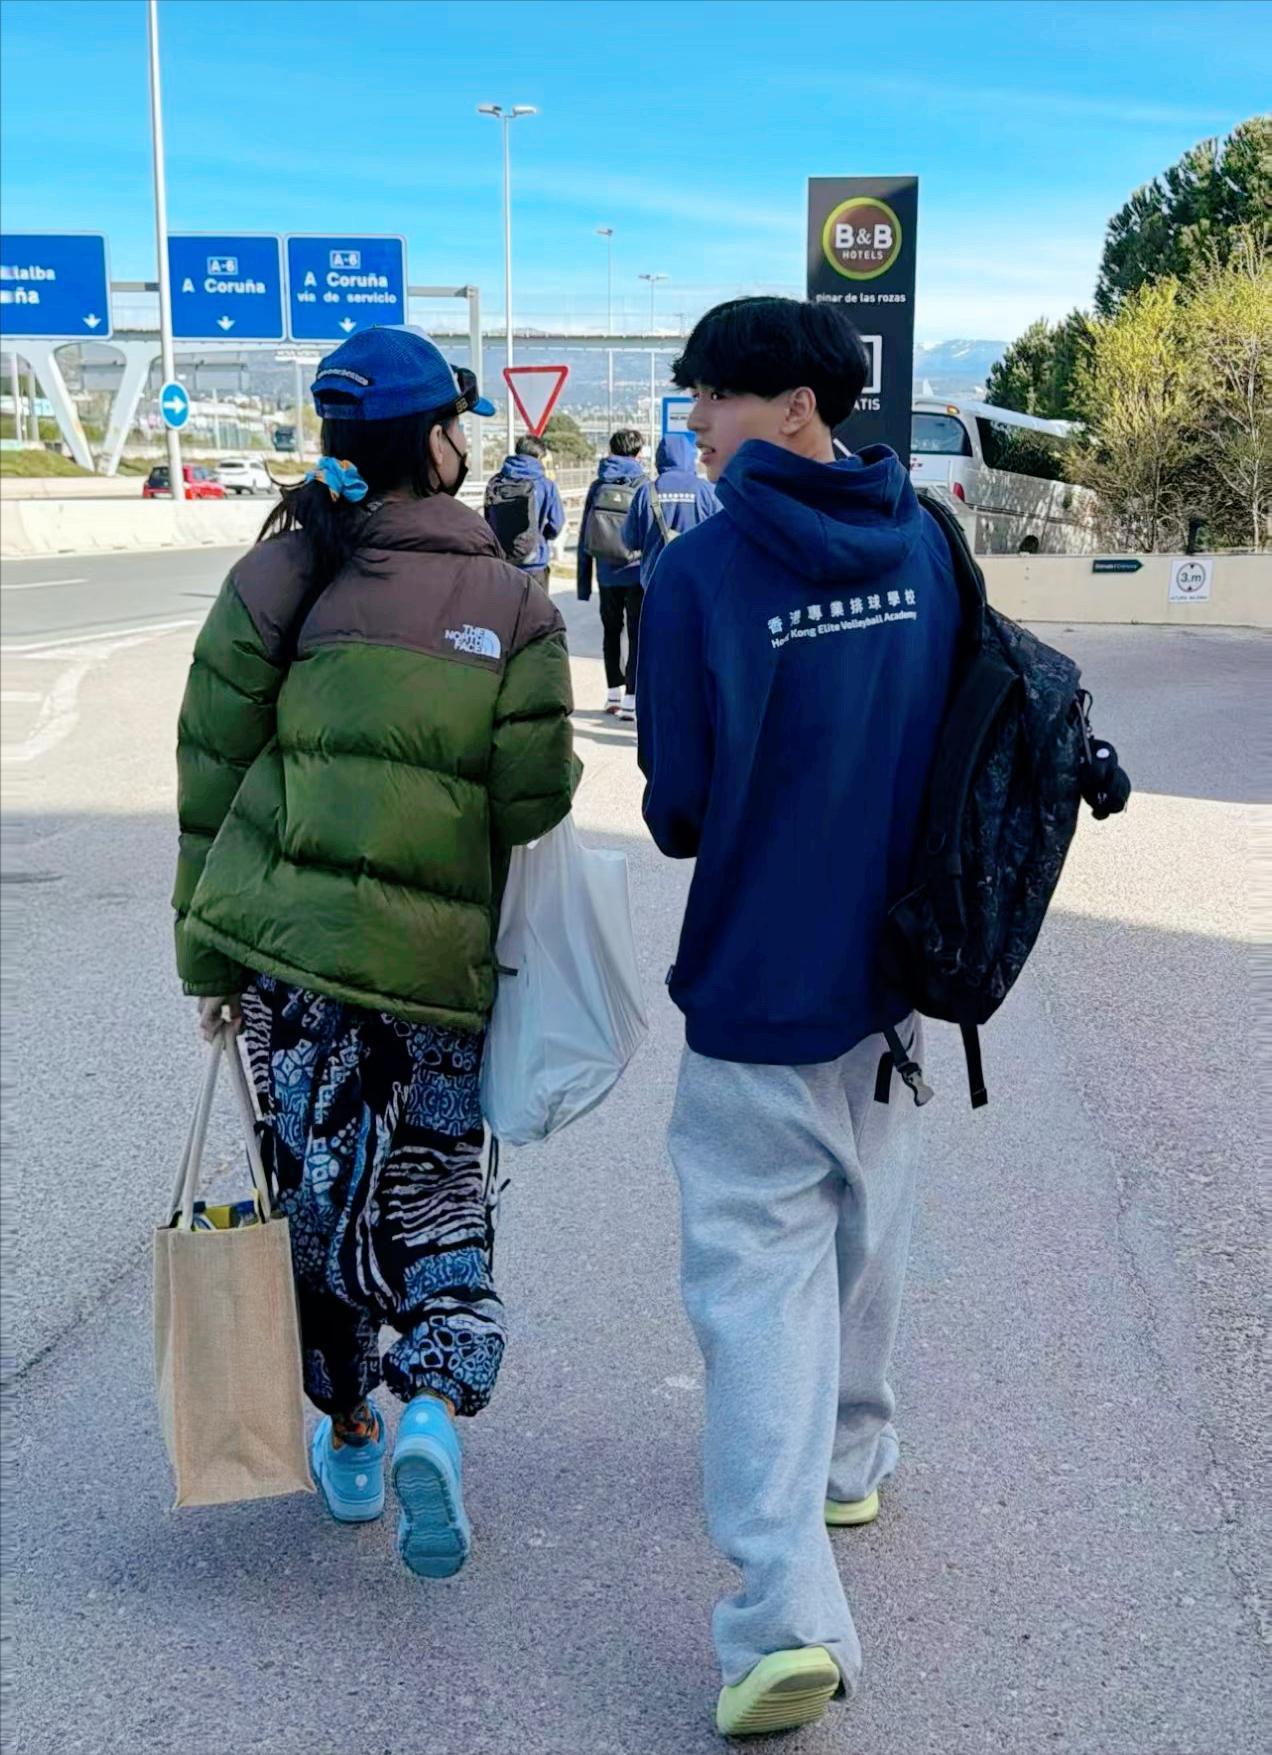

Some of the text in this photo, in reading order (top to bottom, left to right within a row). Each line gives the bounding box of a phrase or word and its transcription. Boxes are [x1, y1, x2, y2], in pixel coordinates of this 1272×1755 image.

[835, 223, 893, 249] B&B
[333, 253, 358, 266] A-6
[842, 250, 884, 260] HOTELS
[210, 259, 236, 272] A-6
[182, 277, 266, 294] A Coruña
[304, 271, 388, 288] A Coruña
[323, 290, 339, 303] de
[346, 291, 397, 304] servicio
[844, 291, 859, 303] de
[860, 291, 877, 303] las
[877, 293, 907, 303] rozas
[790, 627, 817, 638] Kong
[817, 623, 840, 634] Elite
[840, 614, 884, 630] Volleyball
[883, 610, 917, 622] Academy
